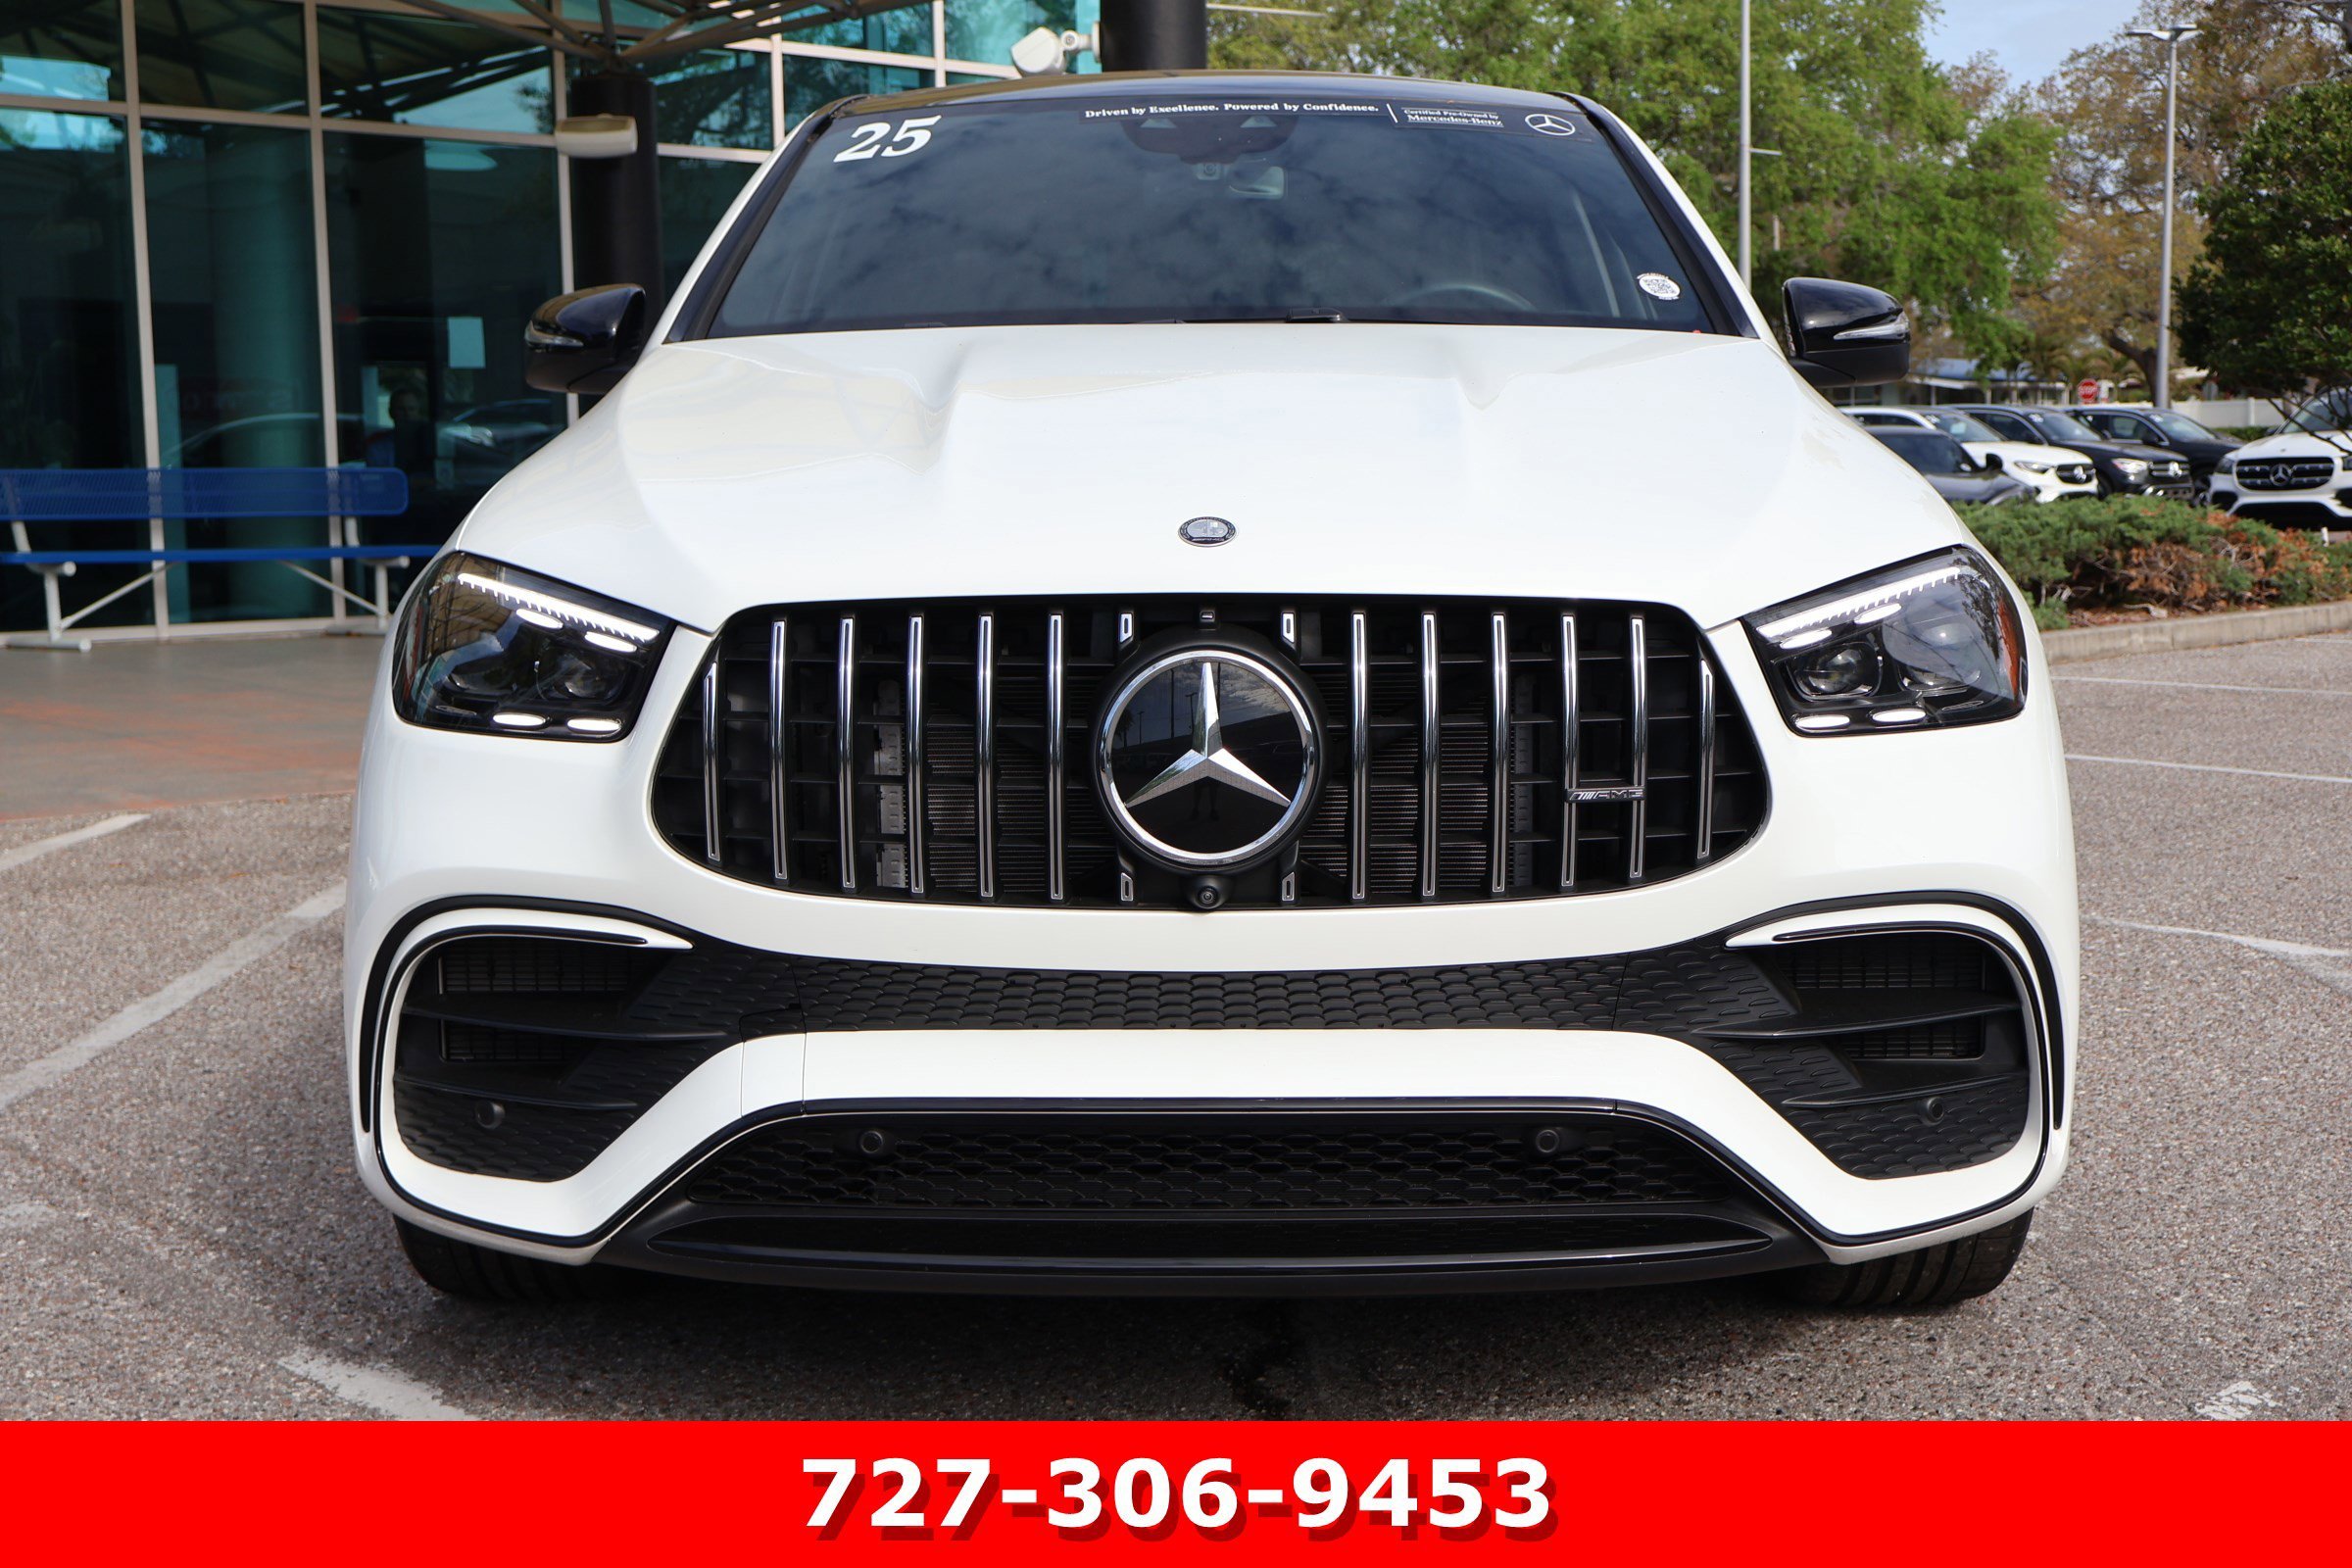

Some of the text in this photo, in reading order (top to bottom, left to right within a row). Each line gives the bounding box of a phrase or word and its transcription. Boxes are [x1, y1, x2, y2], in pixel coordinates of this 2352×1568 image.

[1085, 108, 1128, 118] Driven
[1131, 107, 1146, 116] by
[1150, 104, 1219, 114] Excellence.
[1284, 103, 1299, 112] by
[1303, 103, 1379, 112] Confidence.
[1407, 115, 1503, 126] Mercedes-Benz
[834, 115, 942, 163] 25
[1592, 789, 1643, 800] AMG
